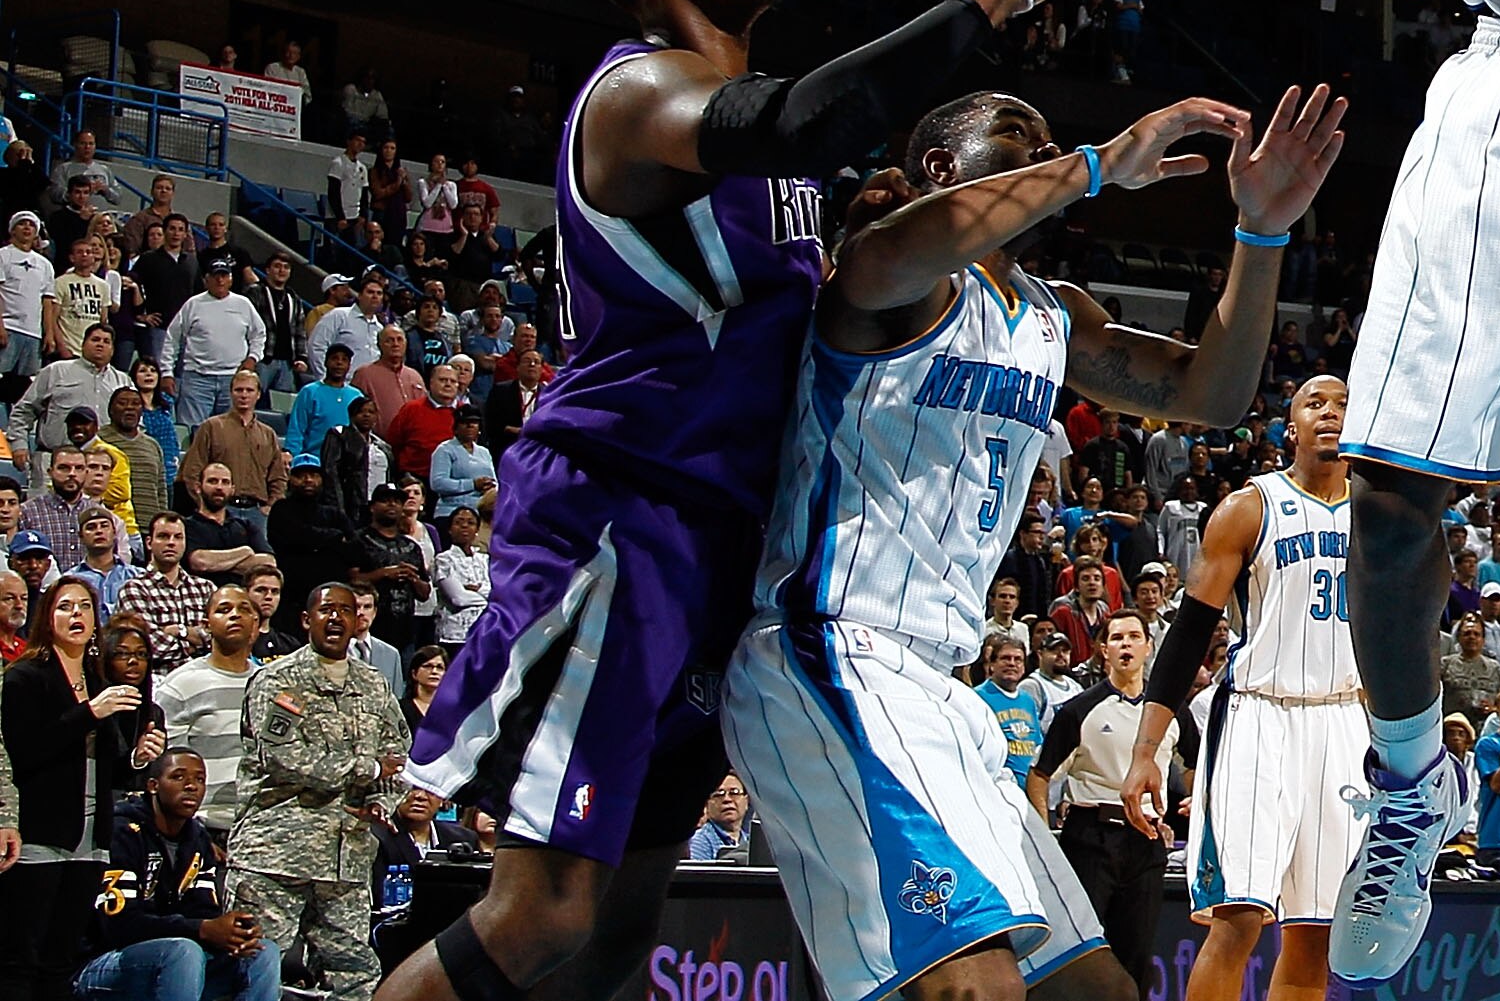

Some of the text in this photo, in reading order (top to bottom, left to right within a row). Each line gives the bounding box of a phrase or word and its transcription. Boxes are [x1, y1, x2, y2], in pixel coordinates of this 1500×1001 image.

[232, 86, 288, 104] VOTE FOR YOUR
[258, 100, 296, 116] ALL-STARS
[977, 437, 1008, 533] 5
[1280, 500, 1298, 515] C
[1274, 531, 1349, 570] NEW ORL
[650, 945, 744, 1001] Step
